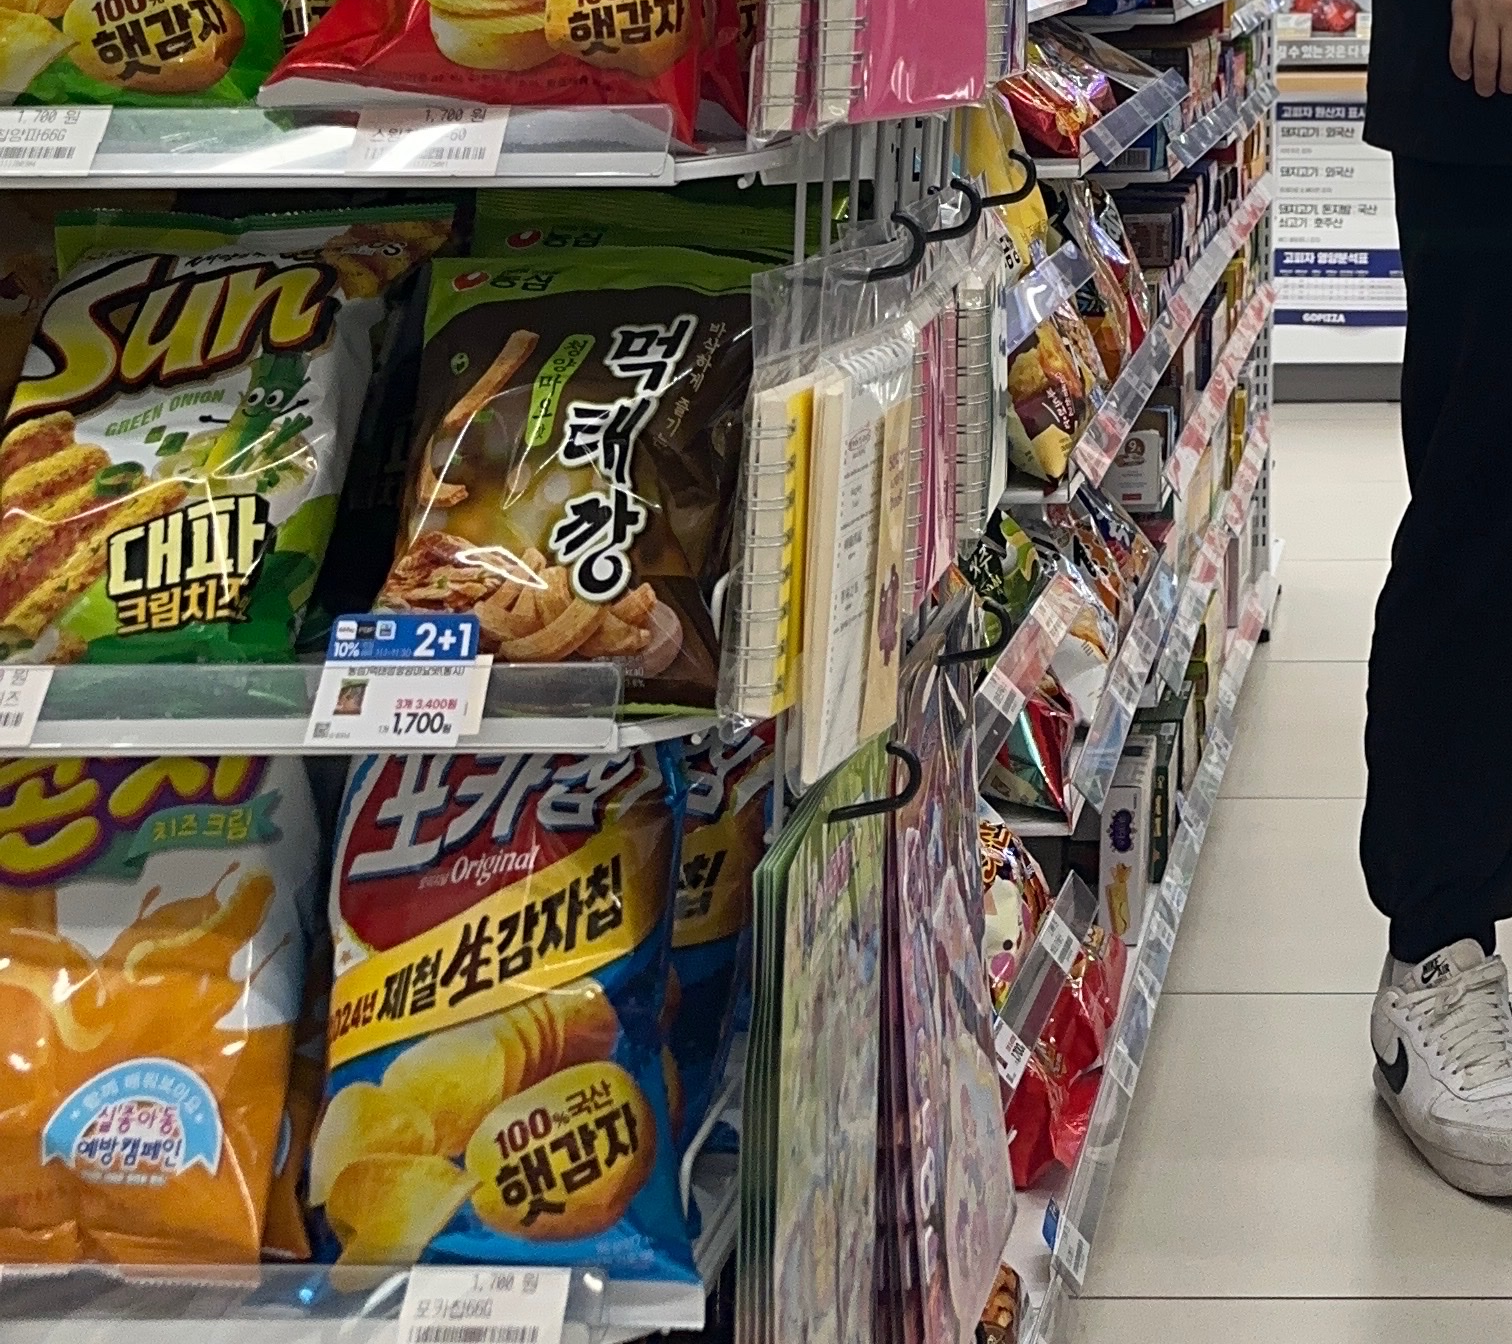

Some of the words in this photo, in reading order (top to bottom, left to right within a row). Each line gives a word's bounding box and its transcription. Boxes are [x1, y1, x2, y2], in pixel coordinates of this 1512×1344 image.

[93, 0, 226, 81] 햇감자
[423, 108, 464, 123] 1,700
[10, 254, 326, 414] Sun
[104, 407, 168, 440] GREEN
[168, 386, 227, 413] ONION
[549, 315, 698, 602] 먹태깡
[107, 497, 268, 598] 대파
[333, 642, 360, 658] 10%
[413, 622, 473, 658] 2+1
[152, 817, 193, 842] 치즈
[202, 810, 252, 841] 크림
[450, 846, 539, 888] Original
[377, 946, 444, 1022] 제철
[440, 853, 625, 1010] 生감자칩
[494, 1107, 570, 1161] 100%
[565, 1080, 616, 1115] 국산
[496, 1104, 640, 1228] 햇감자
